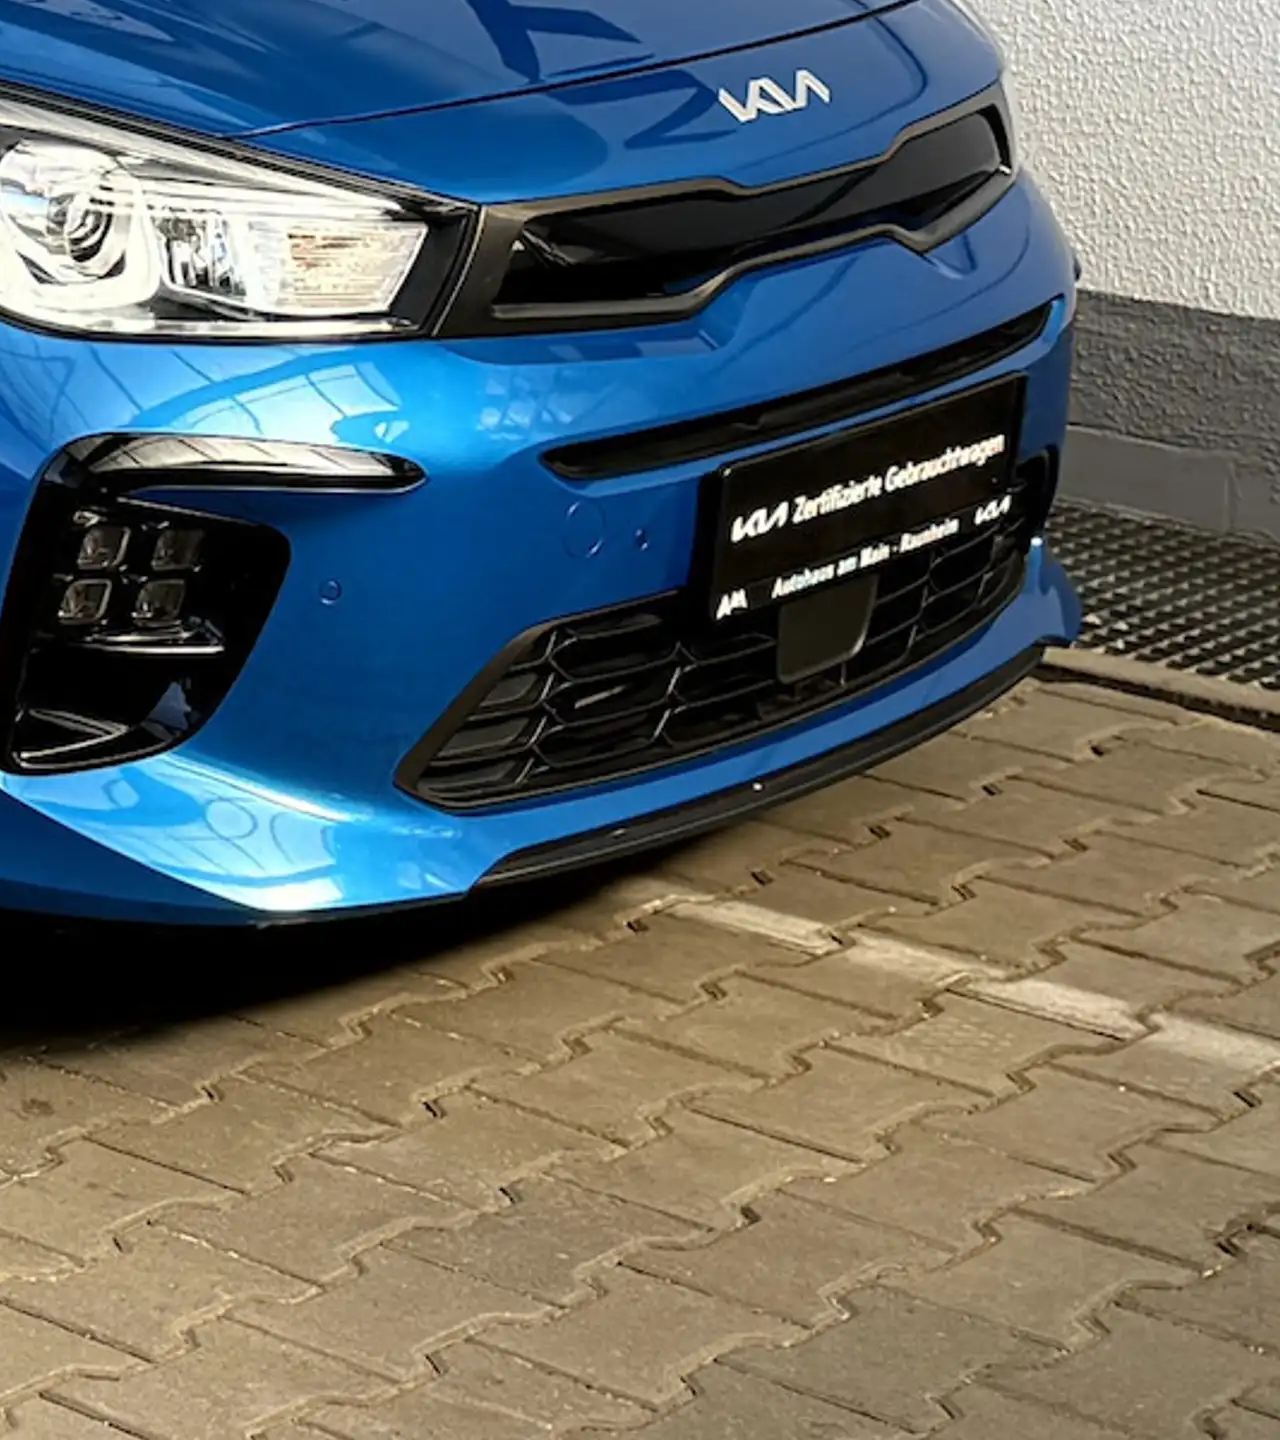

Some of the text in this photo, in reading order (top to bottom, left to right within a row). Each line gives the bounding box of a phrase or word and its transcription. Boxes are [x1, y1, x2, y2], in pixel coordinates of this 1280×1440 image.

[791, 474, 883, 524] Zertifizierte
[884, 434, 1005, 493] Gebrauchtwagen
[771, 563, 835, 599] Autohaus
[836, 556, 858, 577] am
[859, 542, 891, 569] Main
